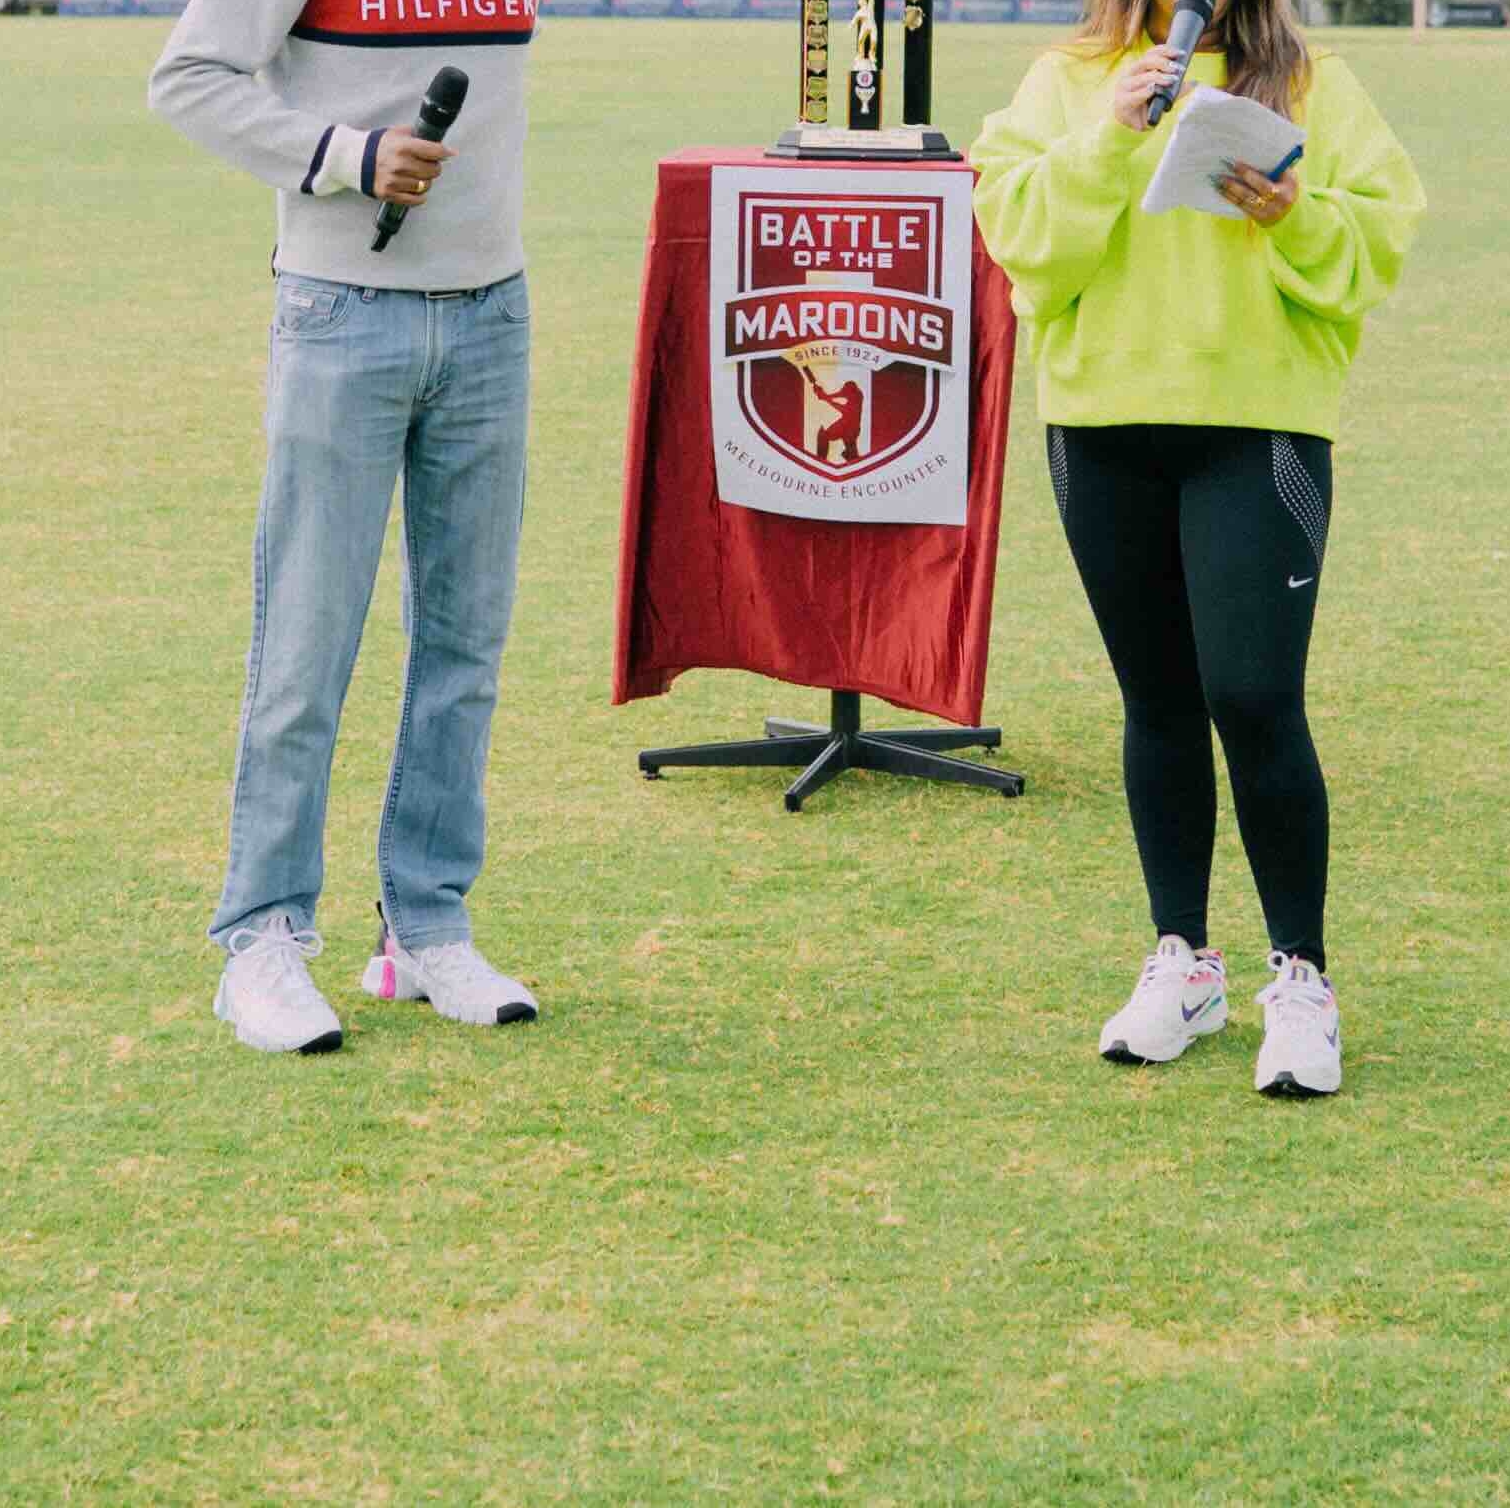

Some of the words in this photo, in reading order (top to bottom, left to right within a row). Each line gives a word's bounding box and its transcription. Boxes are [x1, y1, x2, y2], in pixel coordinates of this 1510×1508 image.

[760, 212, 921, 249] BATTLE
[794, 250, 831, 266] OF
[843, 251, 893, 269] THE
[734, 300, 944, 351] MAROONS
[794, 347, 839, 362] SINCE
[845, 347, 880, 364] 1924
[723, 440, 833, 498] MELBOURNE
[841, 453, 948, 499] ENCOUNTER
